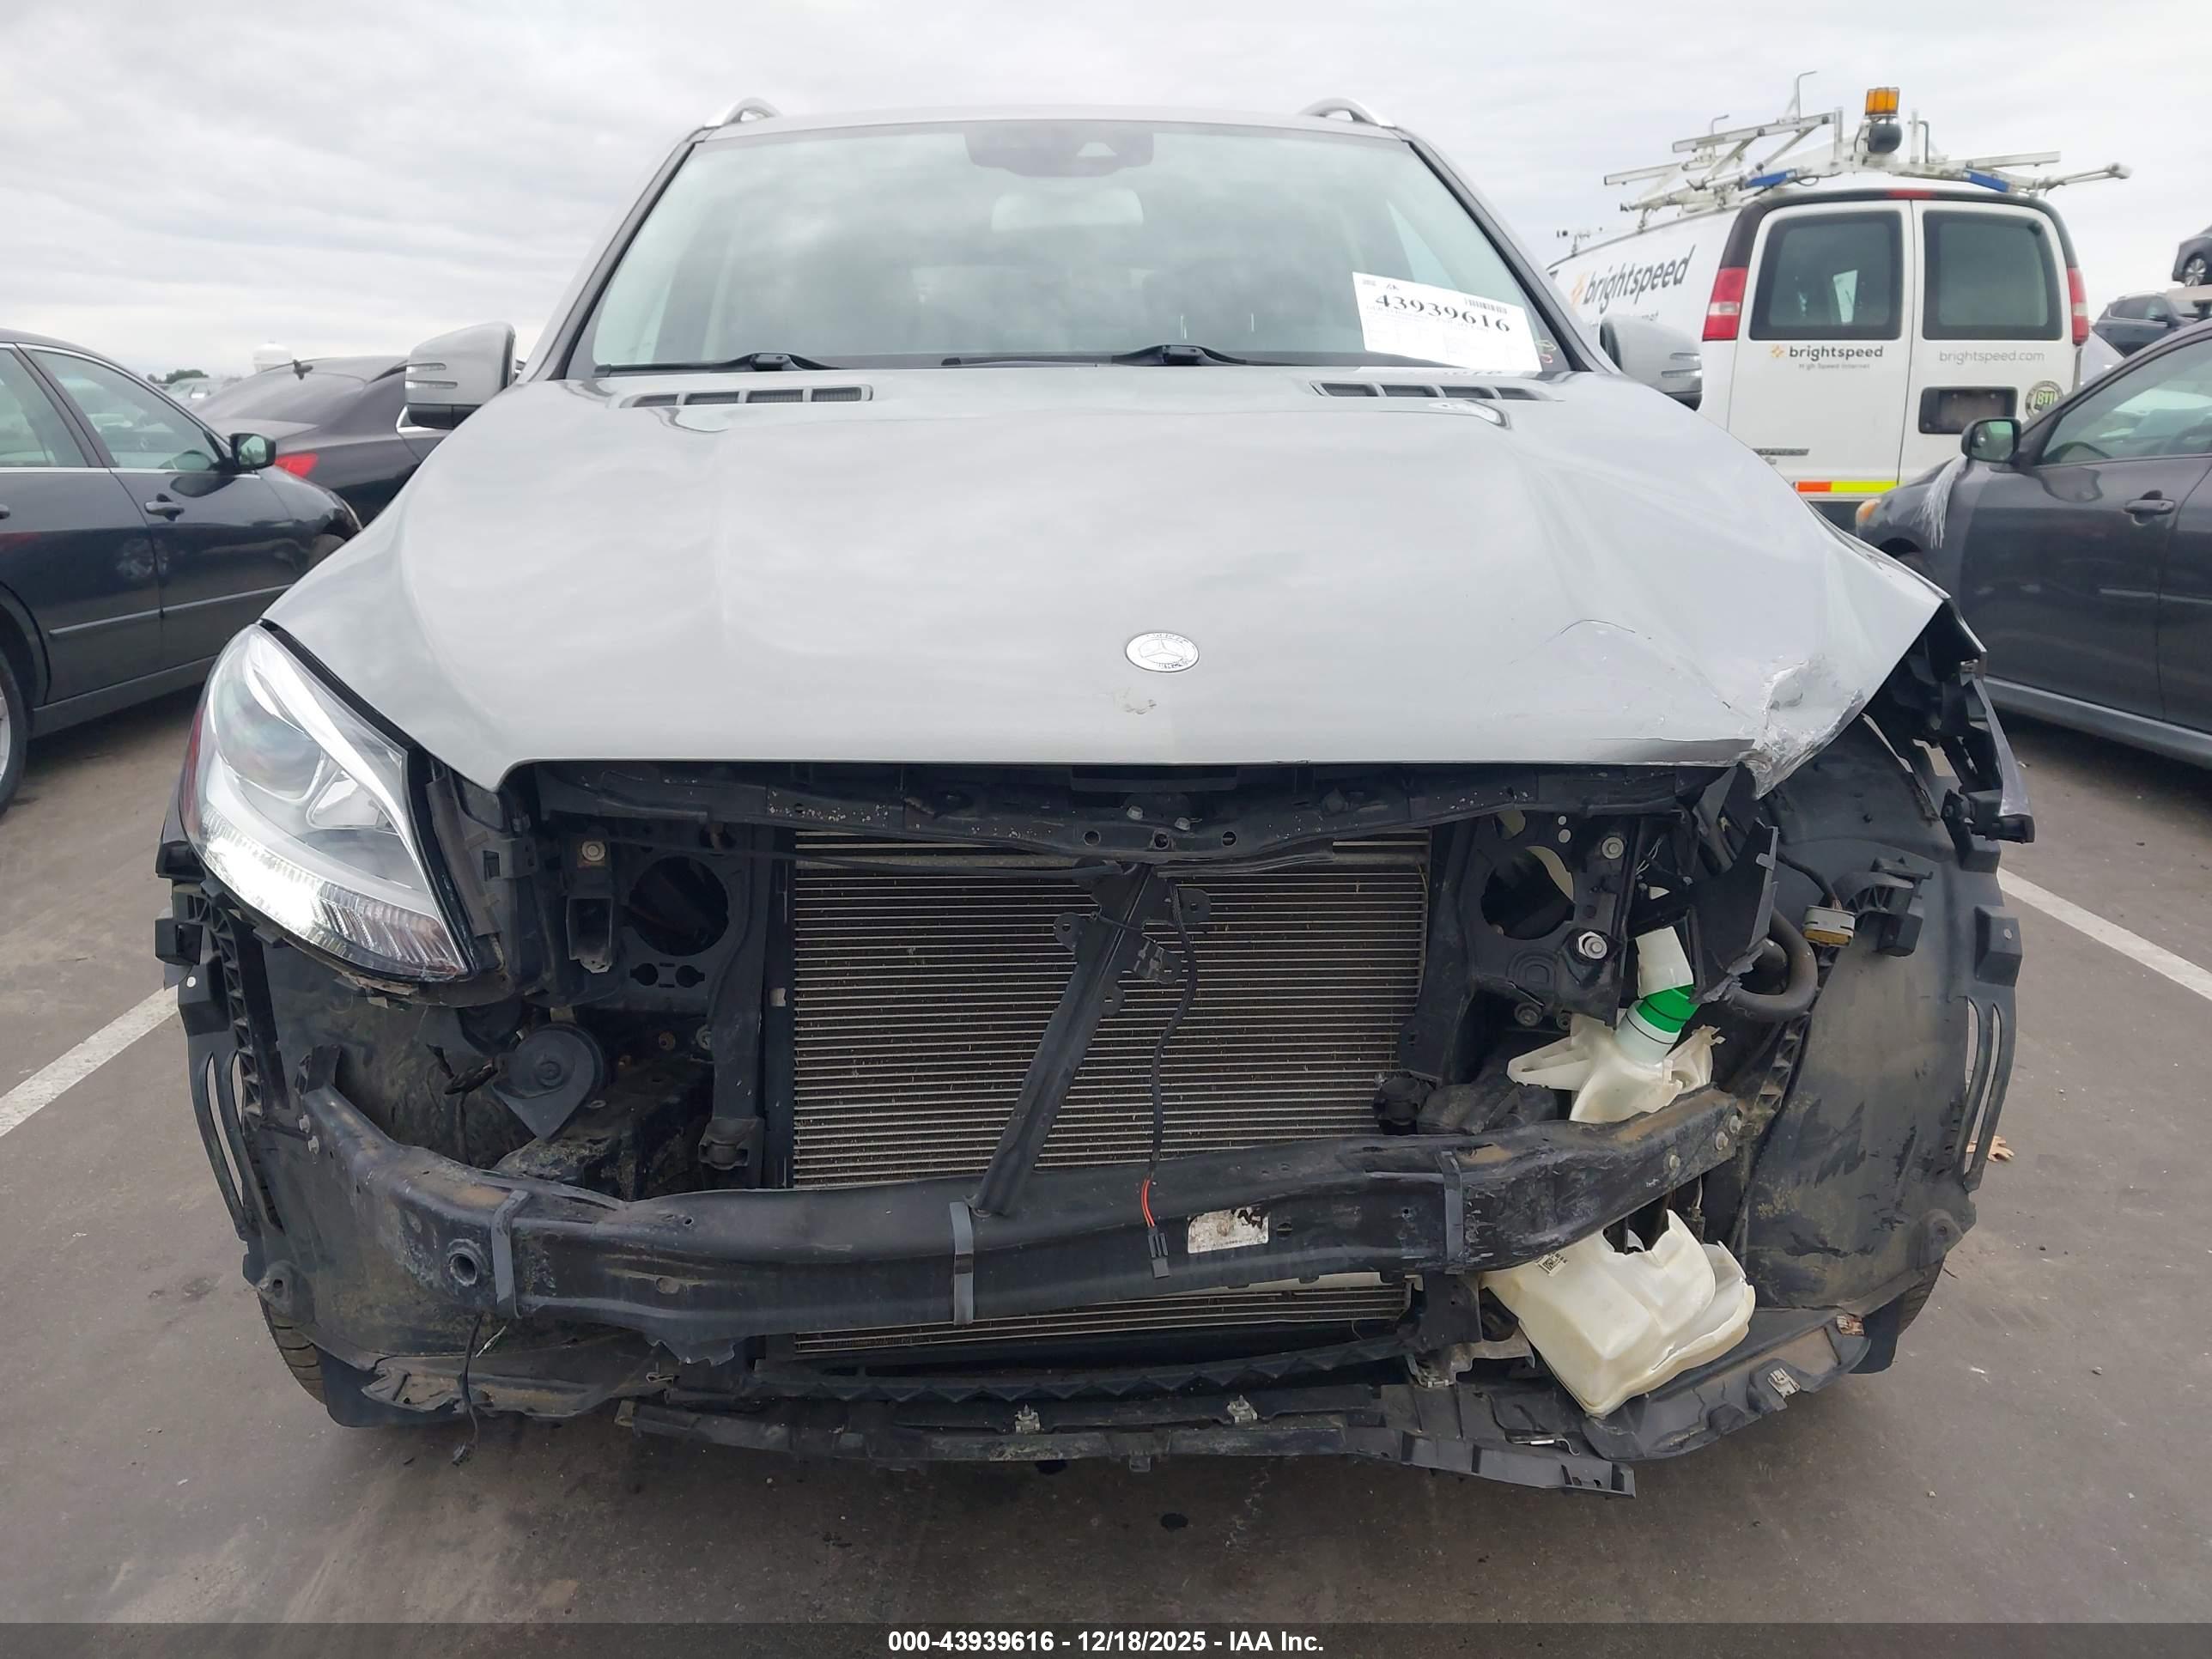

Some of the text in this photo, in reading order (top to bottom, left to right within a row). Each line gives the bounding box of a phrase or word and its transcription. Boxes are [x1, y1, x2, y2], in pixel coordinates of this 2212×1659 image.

[1583, 244, 1696, 314] brightspeed
[1375, 295, 1510, 331] 43939616
[1790, 345, 1884, 362] brightspeed
[1939, 350, 2045, 365] brightspeed.com
